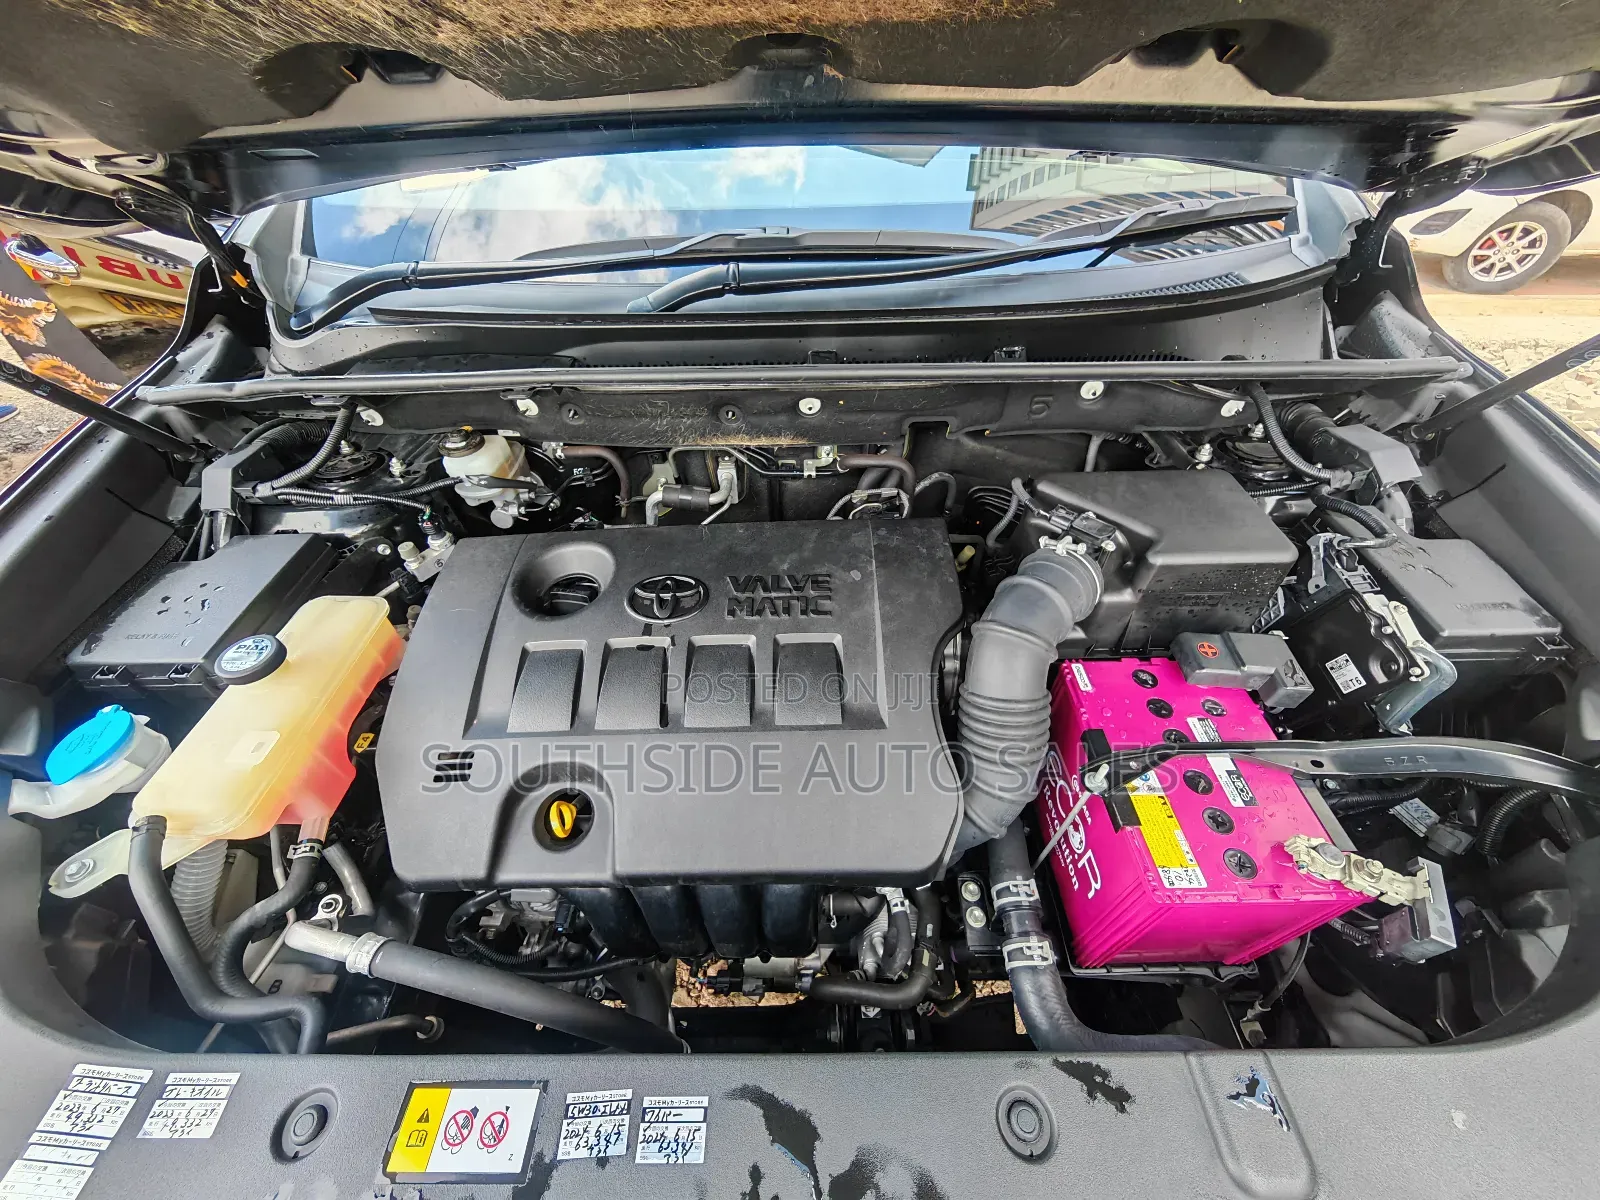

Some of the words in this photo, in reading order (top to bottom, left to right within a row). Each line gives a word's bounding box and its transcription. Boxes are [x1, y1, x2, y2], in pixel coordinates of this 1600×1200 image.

[726, 574, 832, 594] VALVE
[725, 595, 832, 619] MATIC
[268, 979, 283, 994] B
[508, 1153, 514, 1161] Z
